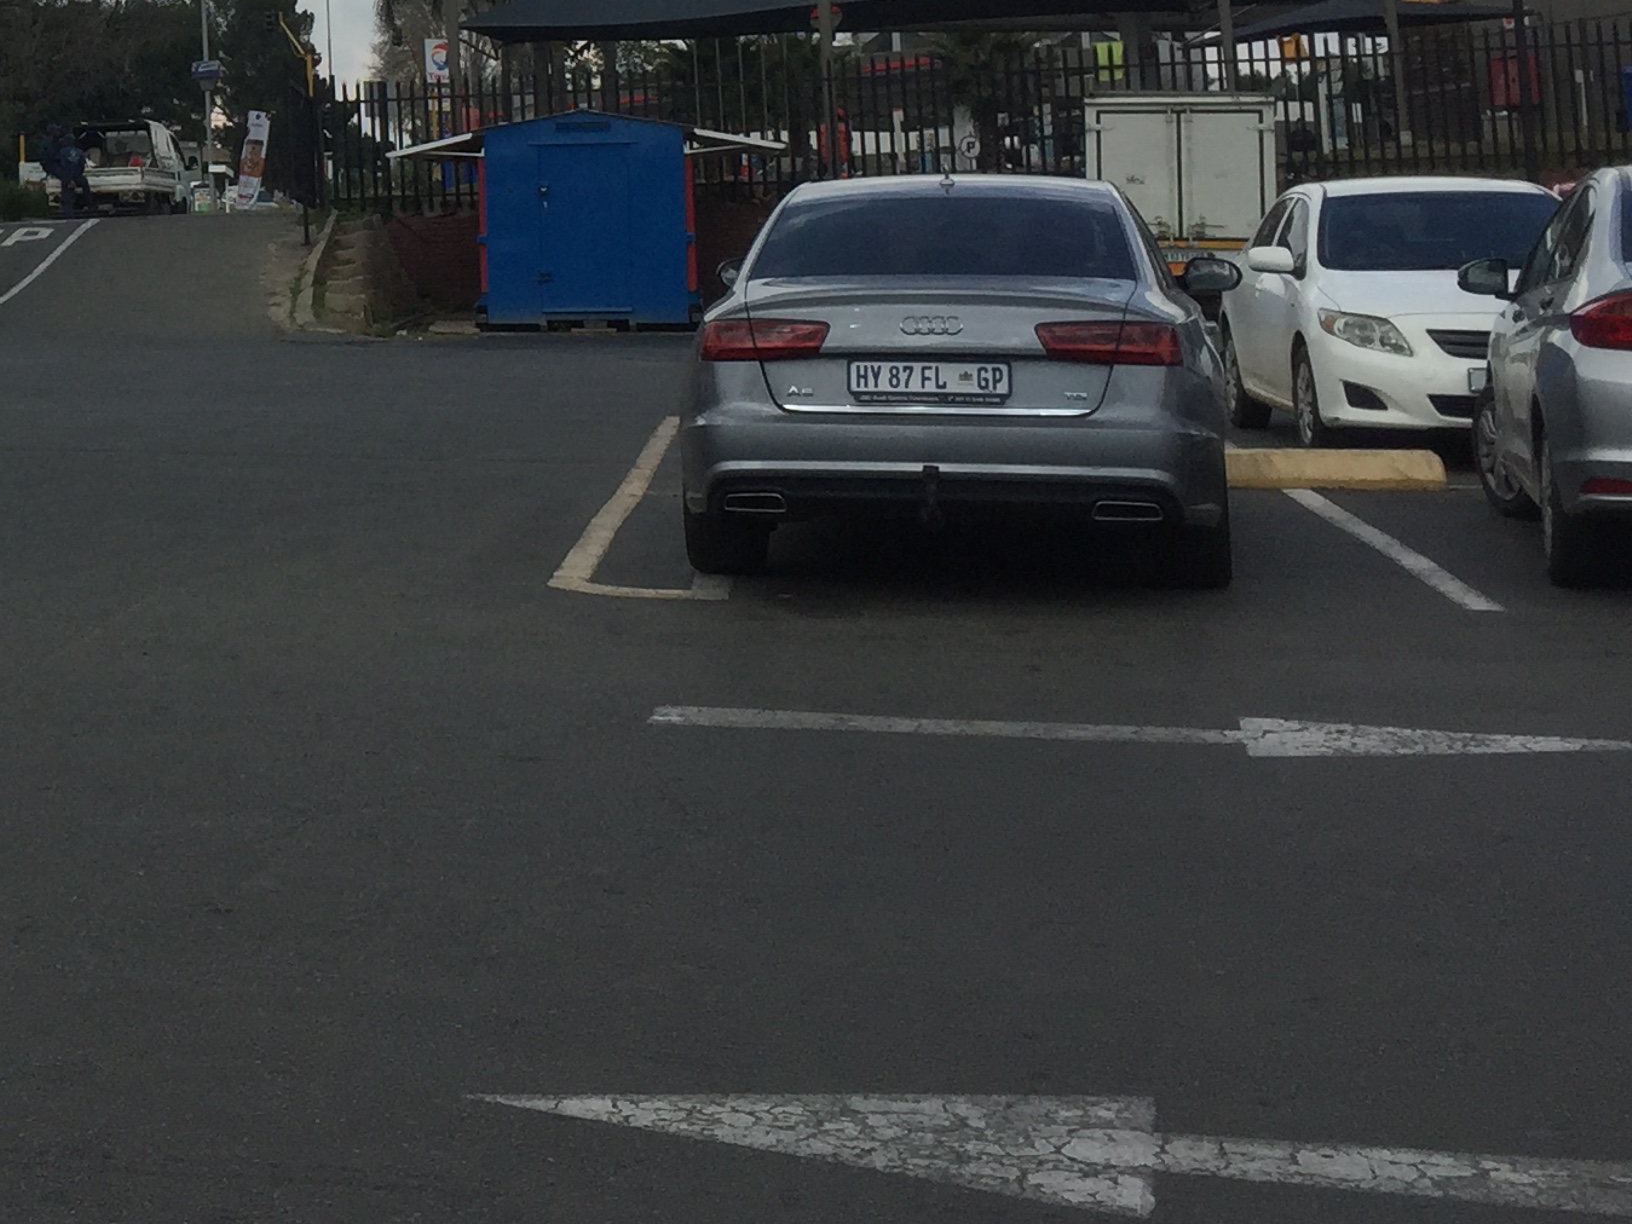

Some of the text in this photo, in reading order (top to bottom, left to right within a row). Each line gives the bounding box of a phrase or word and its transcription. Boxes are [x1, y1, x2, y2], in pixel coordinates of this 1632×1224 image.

[855, 364, 1004, 391] HY 87 FL GP
